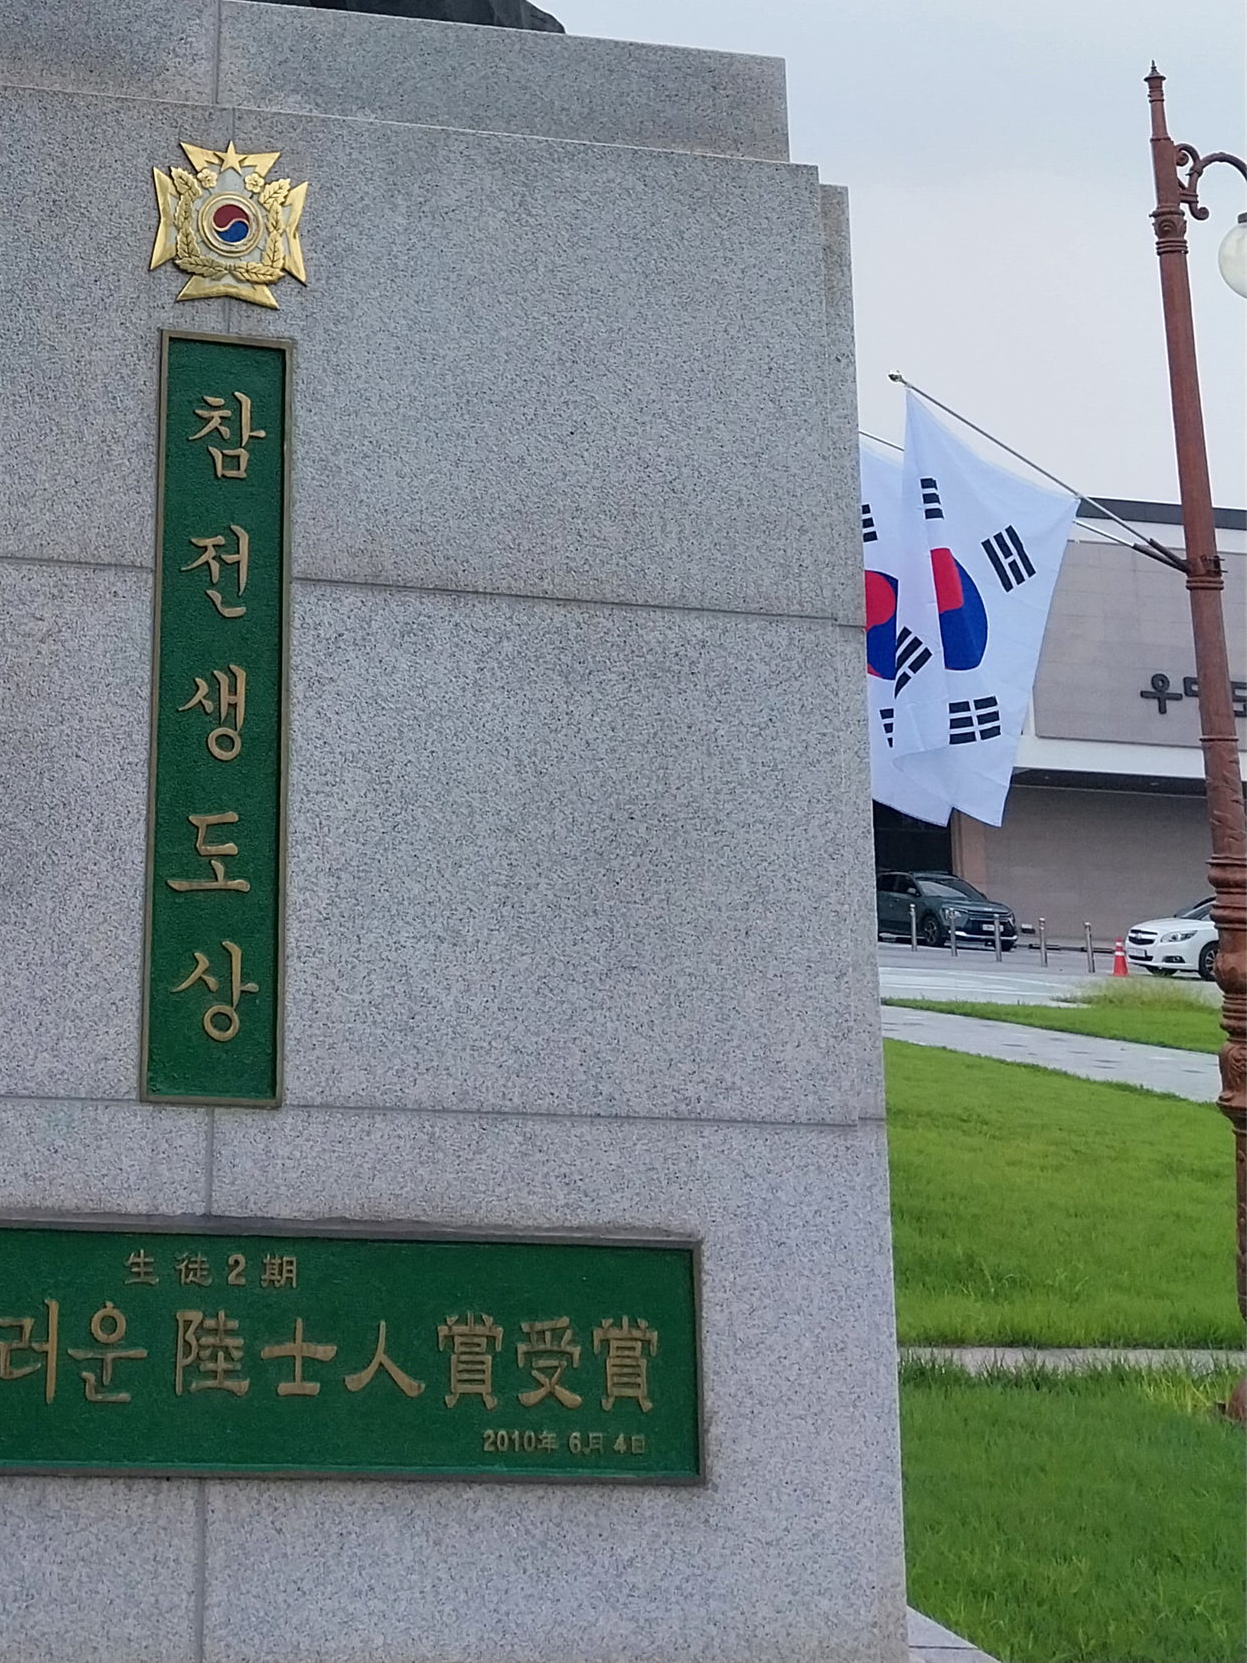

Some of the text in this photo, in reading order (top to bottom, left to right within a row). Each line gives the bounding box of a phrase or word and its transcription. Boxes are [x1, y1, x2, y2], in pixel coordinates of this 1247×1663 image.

[166, 391, 266, 1042] 참전생도상
[483, 1429, 557, 1453] 2010年
[568, 1431, 603, 1455] 6月
